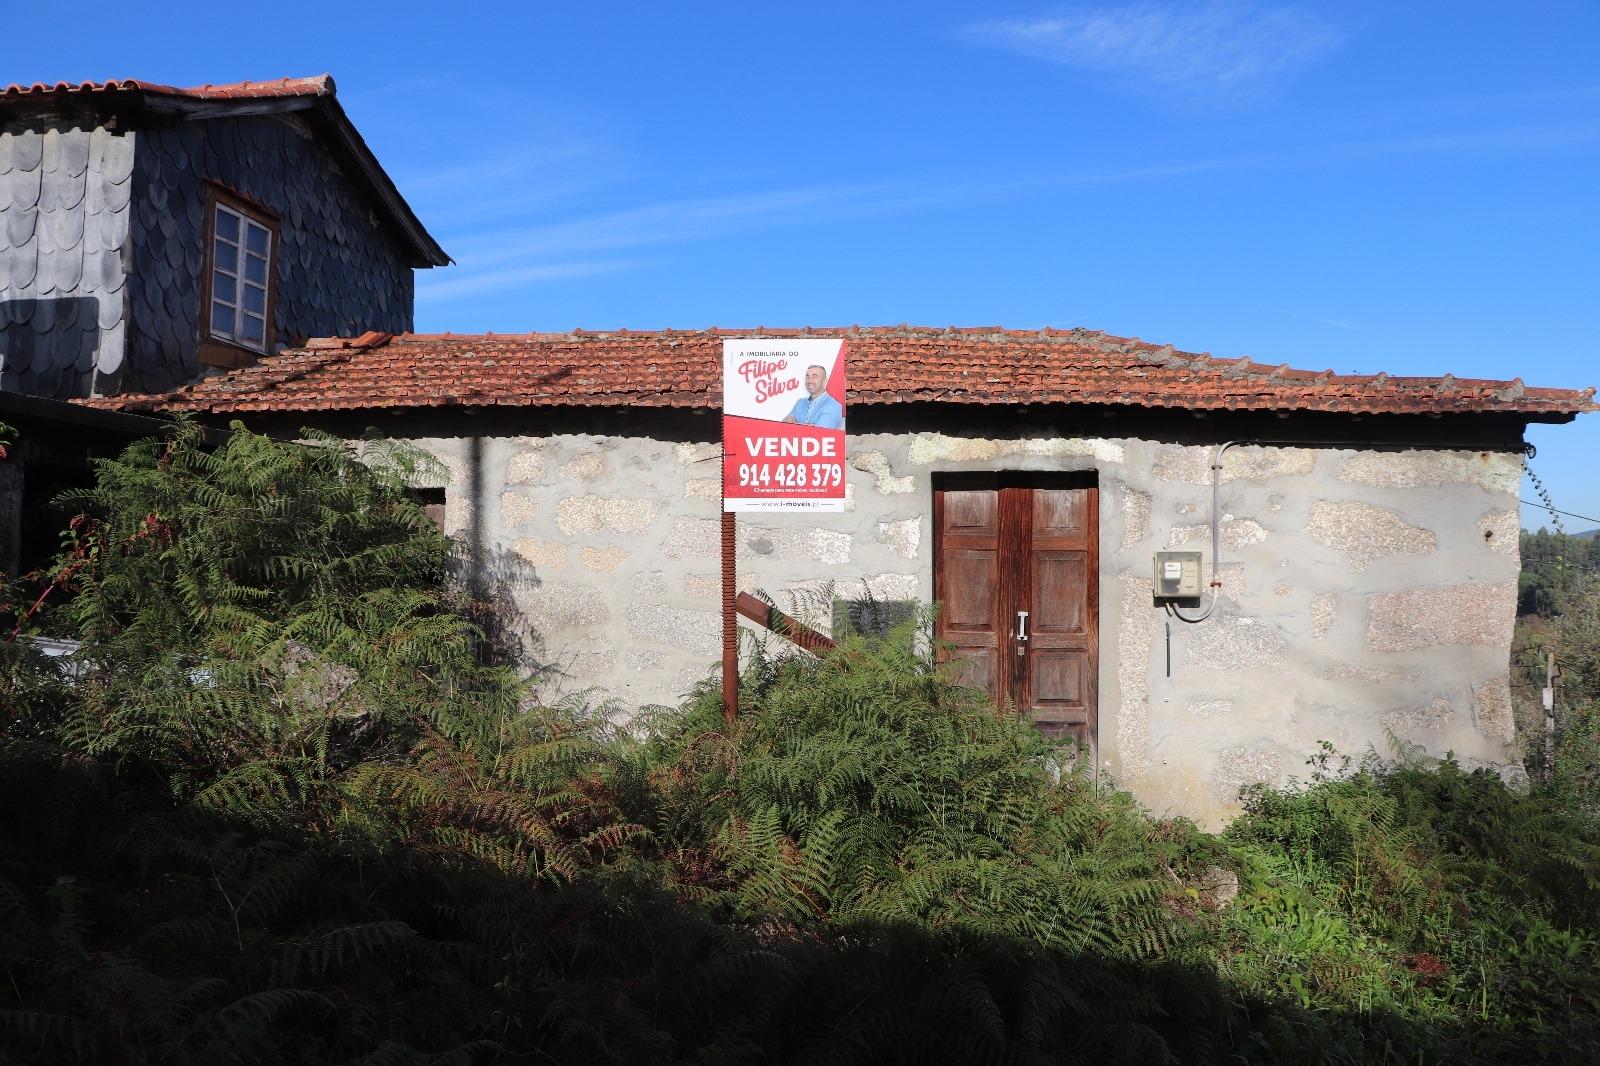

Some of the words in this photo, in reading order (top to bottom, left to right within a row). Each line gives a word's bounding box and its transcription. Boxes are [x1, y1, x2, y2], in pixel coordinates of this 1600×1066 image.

[738, 359, 788, 383] Filipe
[755, 377, 800, 403] Silva
[745, 437, 836, 457] VENDE
[739, 463, 770, 487] 914
[774, 463, 807, 487] 428
[811, 463, 842, 487] 379
